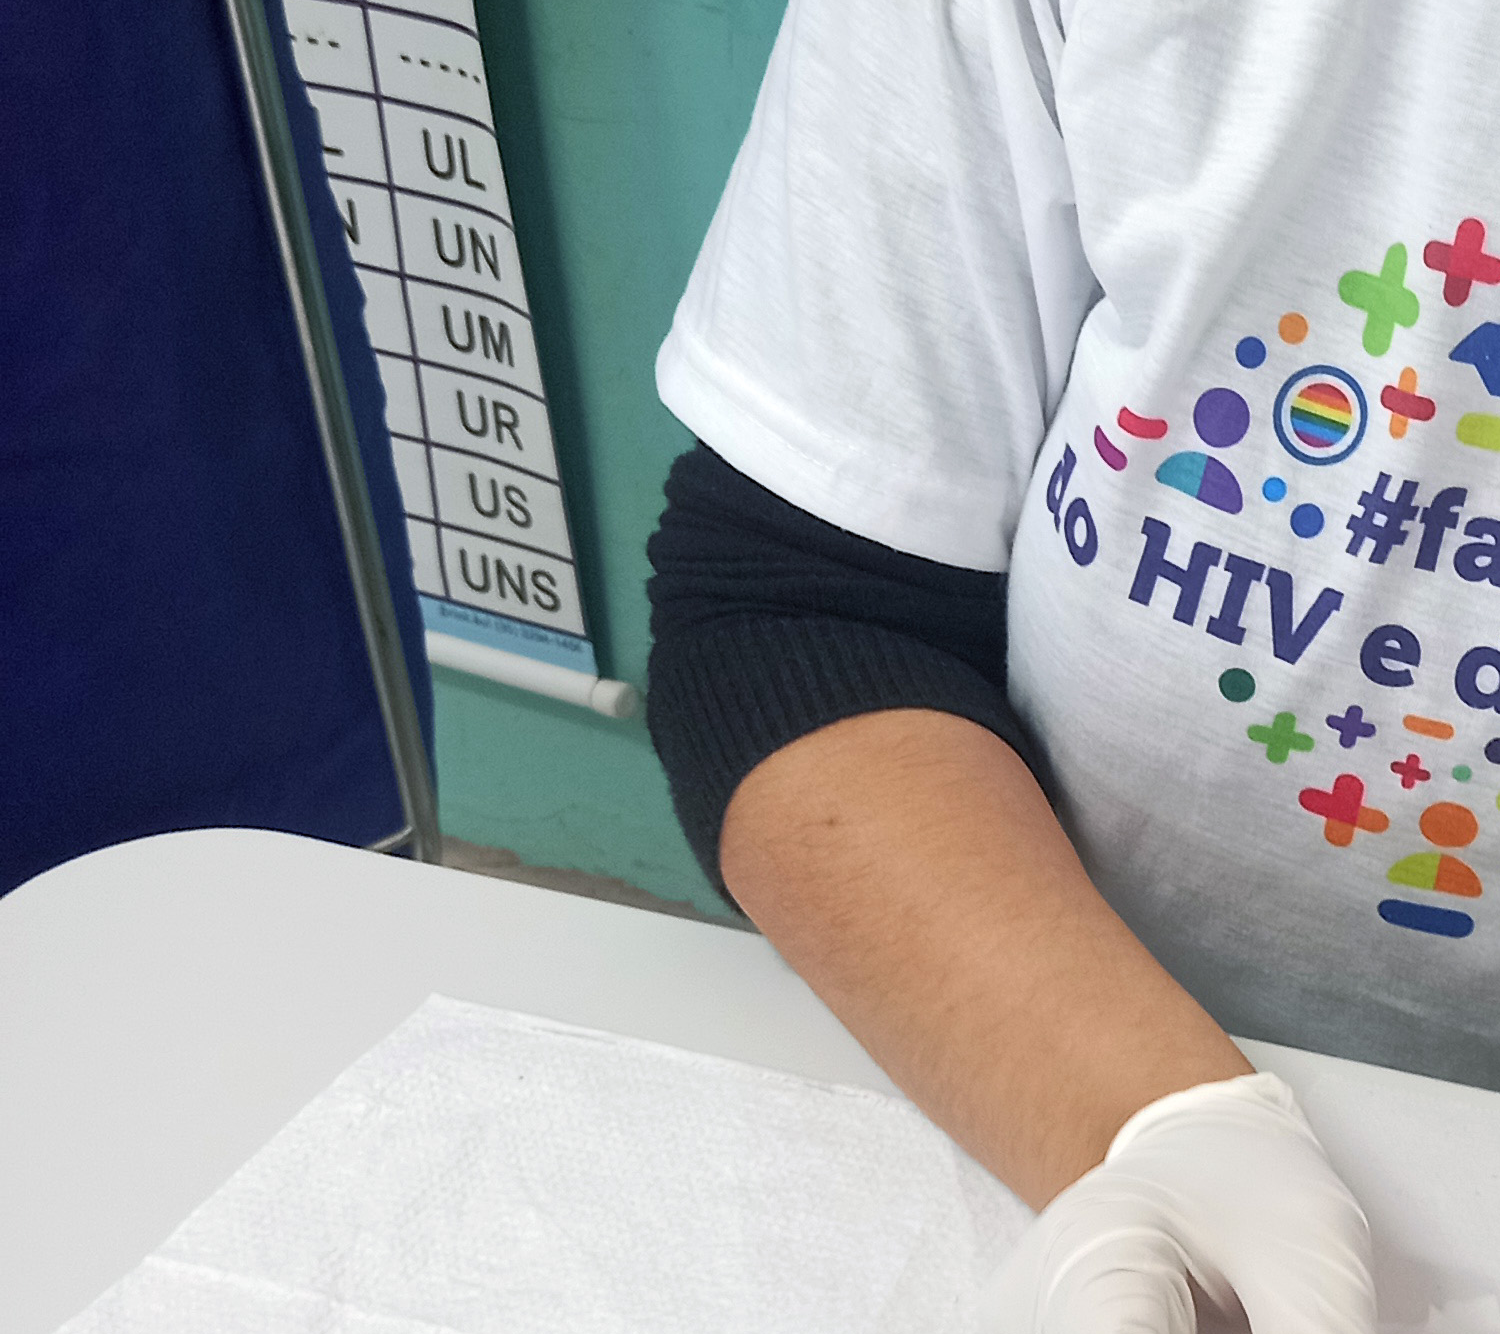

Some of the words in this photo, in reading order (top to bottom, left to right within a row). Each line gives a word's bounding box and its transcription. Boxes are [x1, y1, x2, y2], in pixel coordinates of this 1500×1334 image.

[422, 127, 487, 193] UL
[432, 216, 501, 282] UN
[442, 304, 515, 369] UM
[456, 389, 525, 452] UR
[468, 471, 533, 530] US
[459, 547, 562, 613] UNS
[1046, 442, 1099, 567] do
[1128, 516, 1345, 665] HIV
[1359, 624, 1422, 688] e
